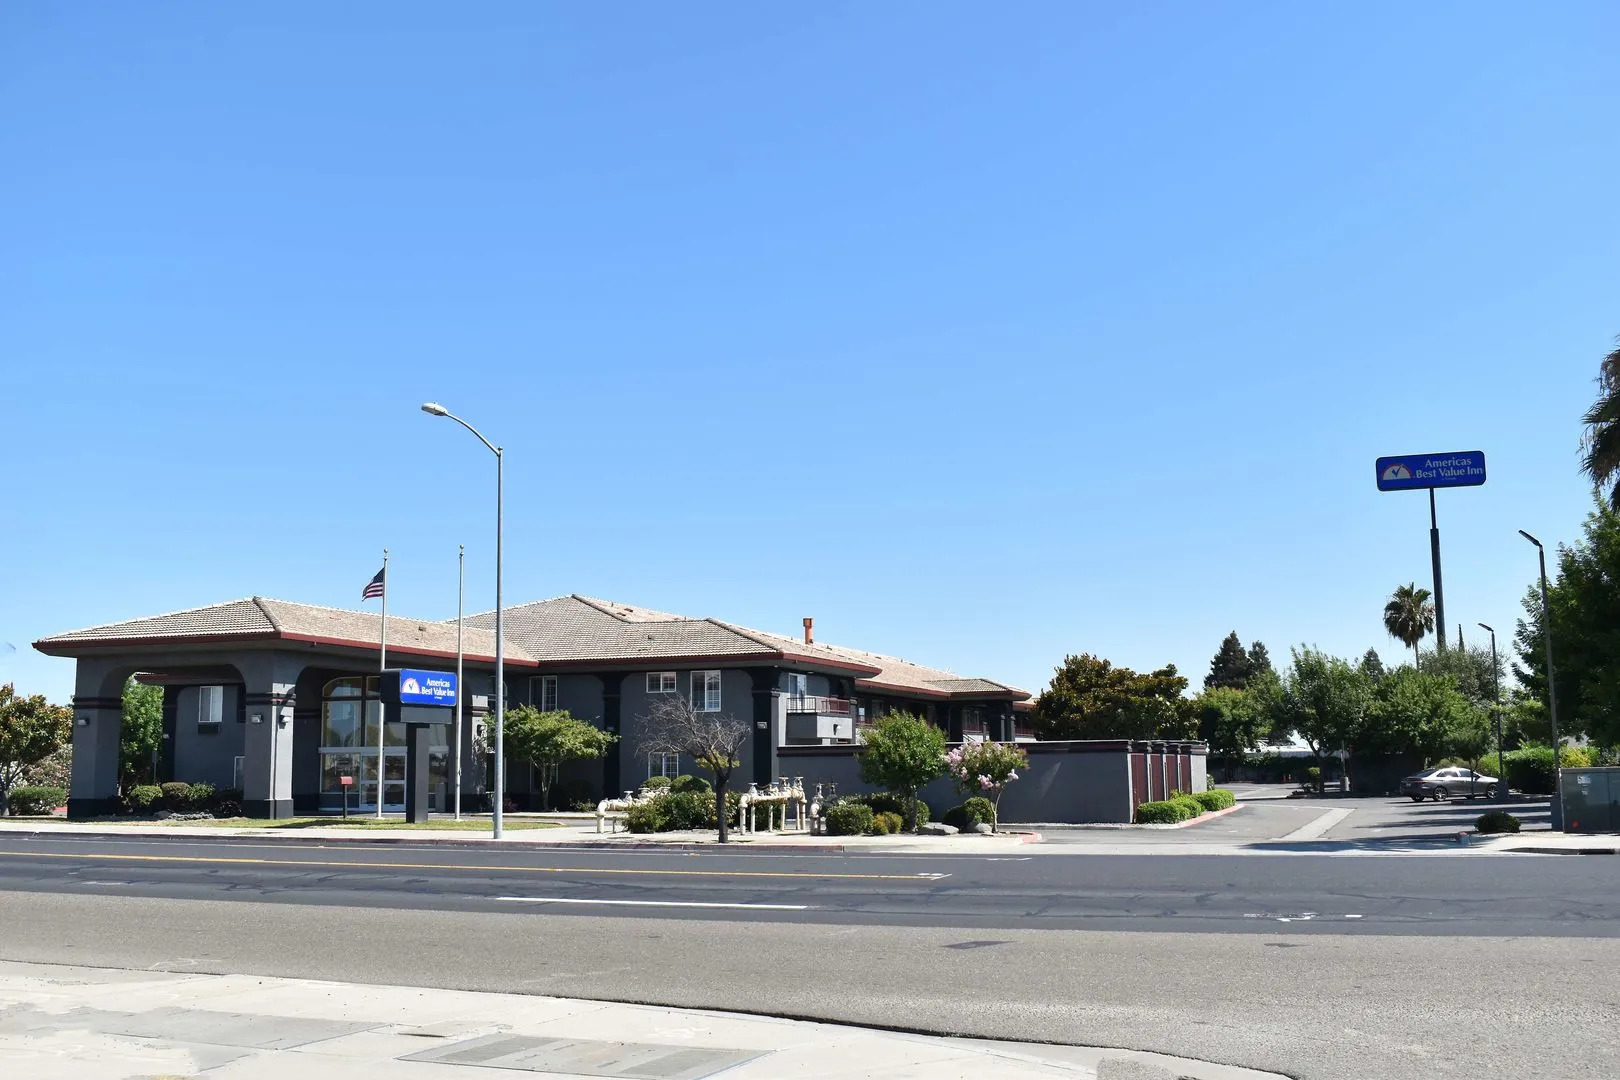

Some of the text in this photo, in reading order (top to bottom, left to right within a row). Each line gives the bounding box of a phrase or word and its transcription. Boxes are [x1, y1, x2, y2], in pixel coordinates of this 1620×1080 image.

[1425, 457, 1471, 467] Americas
[1416, 466, 1483, 479] Best Value Inn
[427, 678, 450, 687] Americas
[421, 686, 455, 697] Best Value Inn
